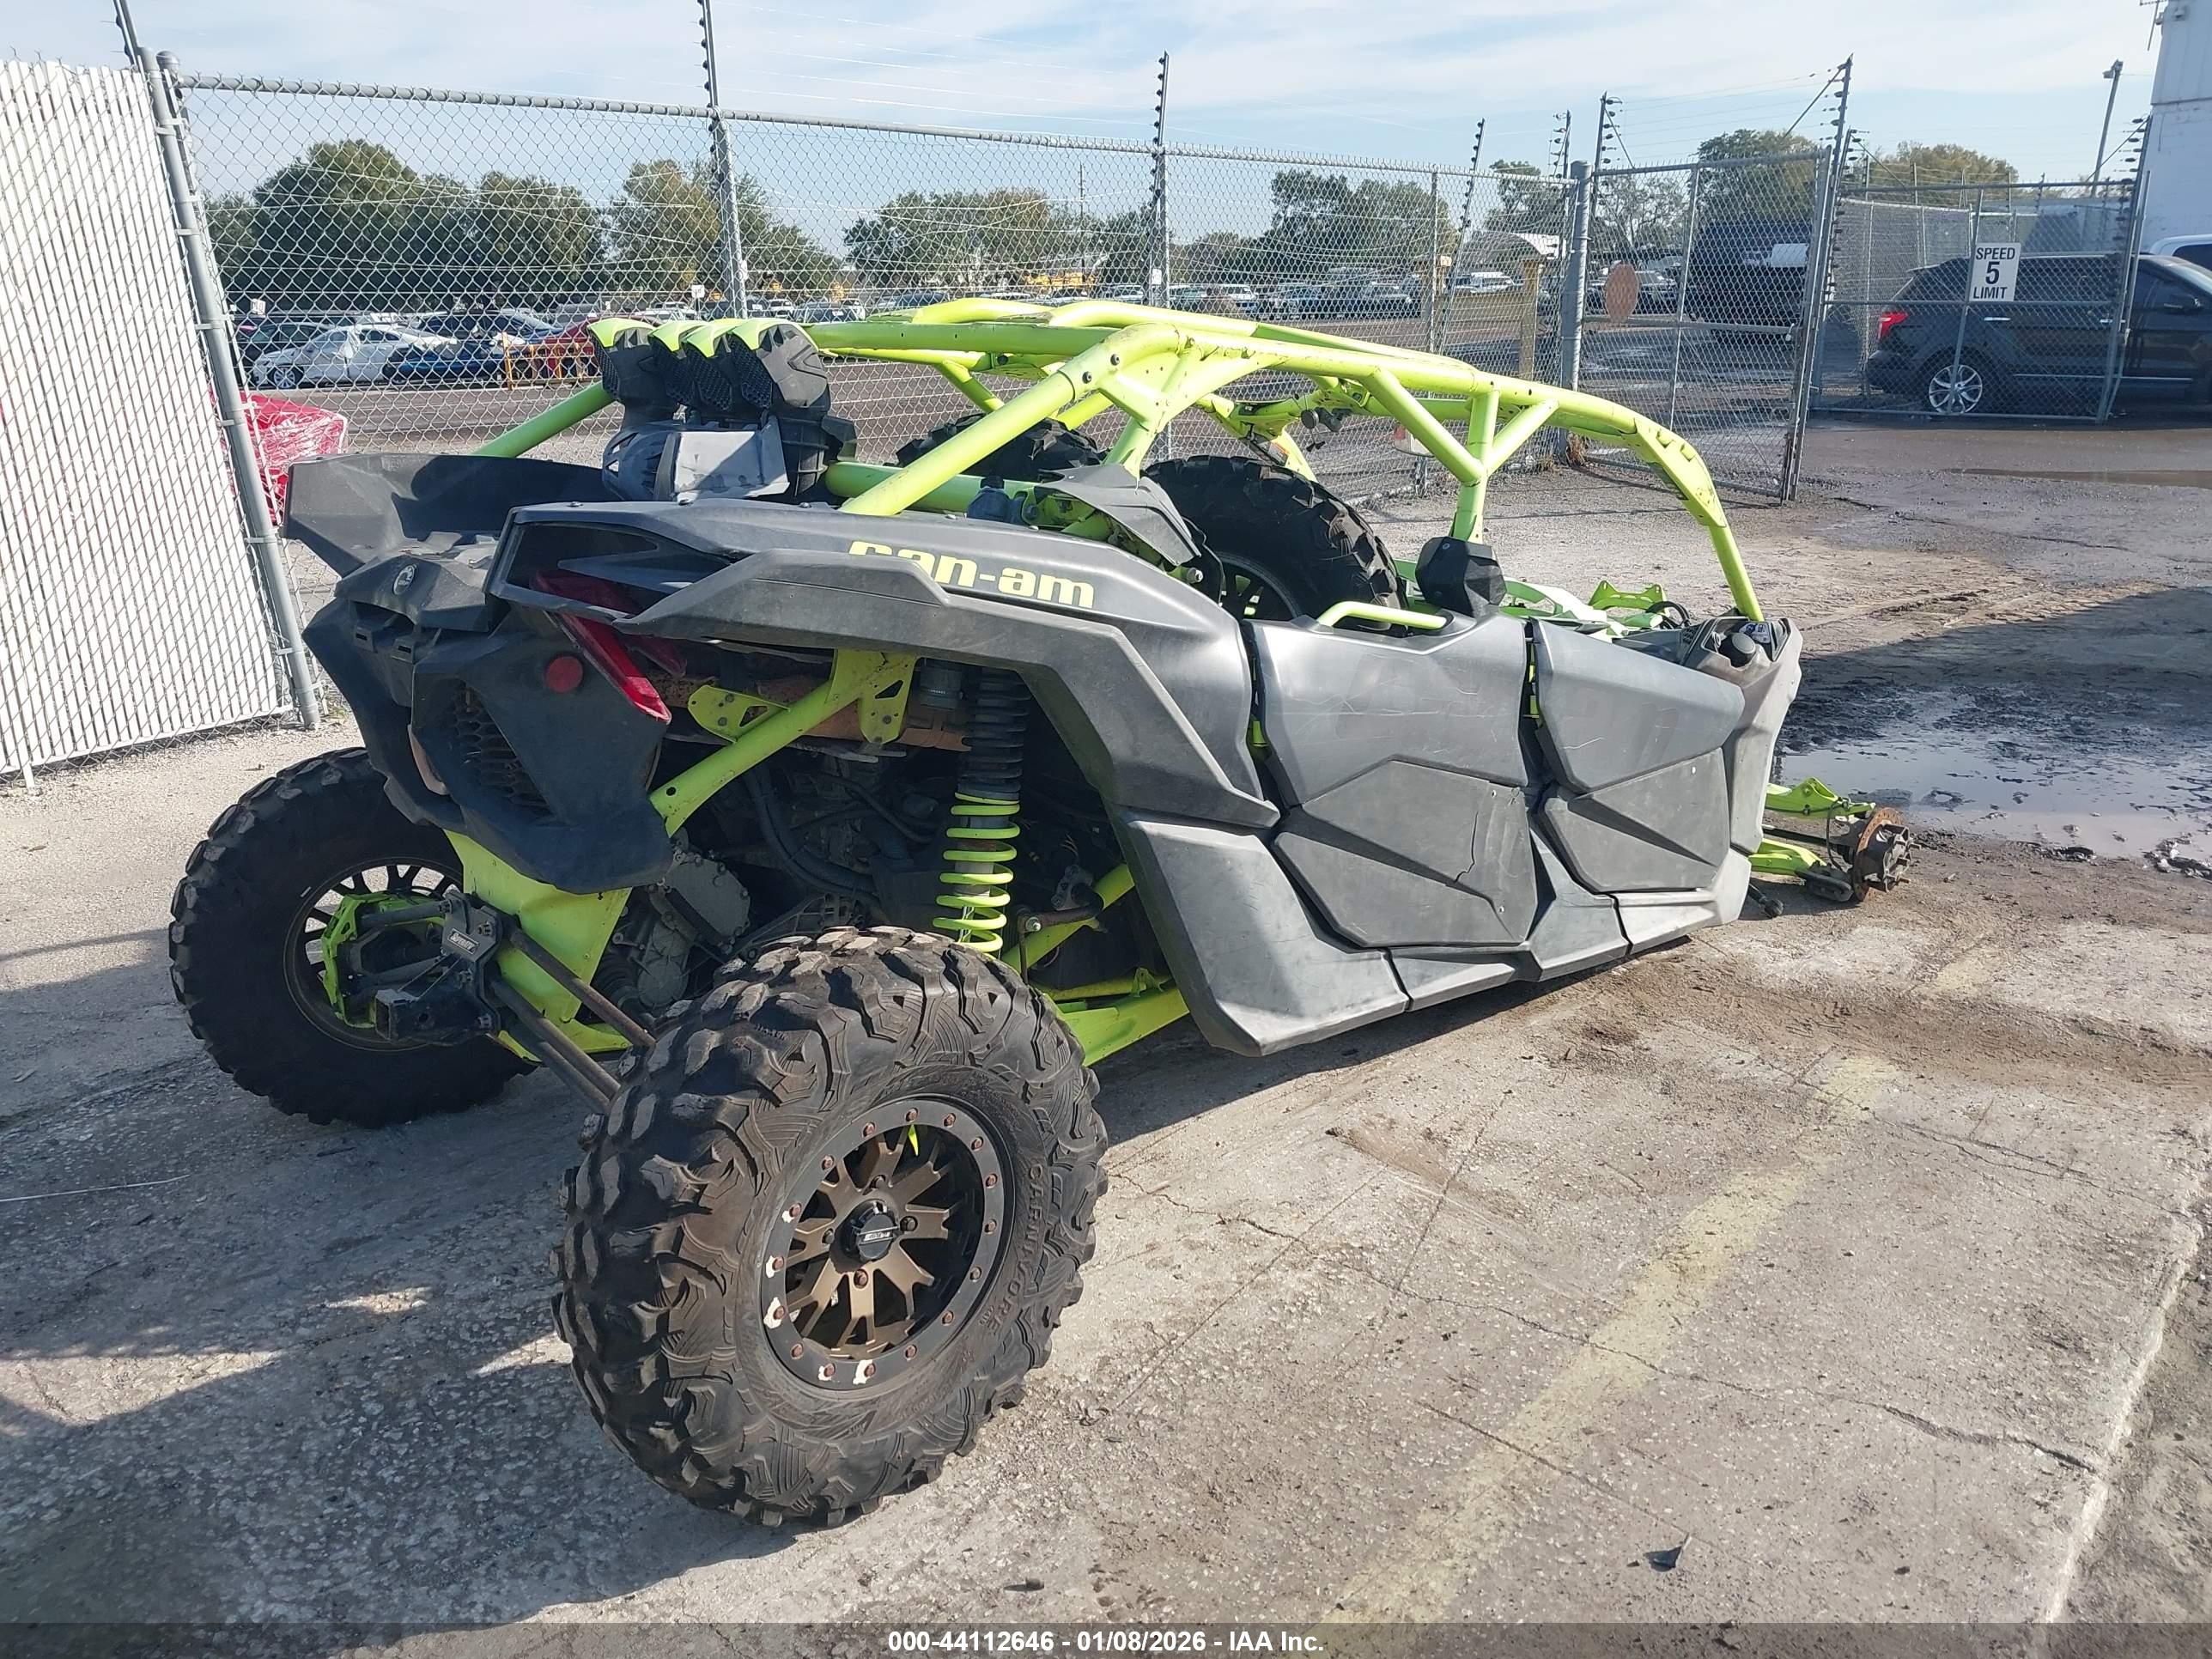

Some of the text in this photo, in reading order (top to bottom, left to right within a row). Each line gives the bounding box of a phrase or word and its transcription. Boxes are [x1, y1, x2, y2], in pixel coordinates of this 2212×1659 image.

[1975, 246, 2015, 260] SPEED
[1984, 260, 2000, 284] 5
[1972, 286, 2008, 299] LIMIT
